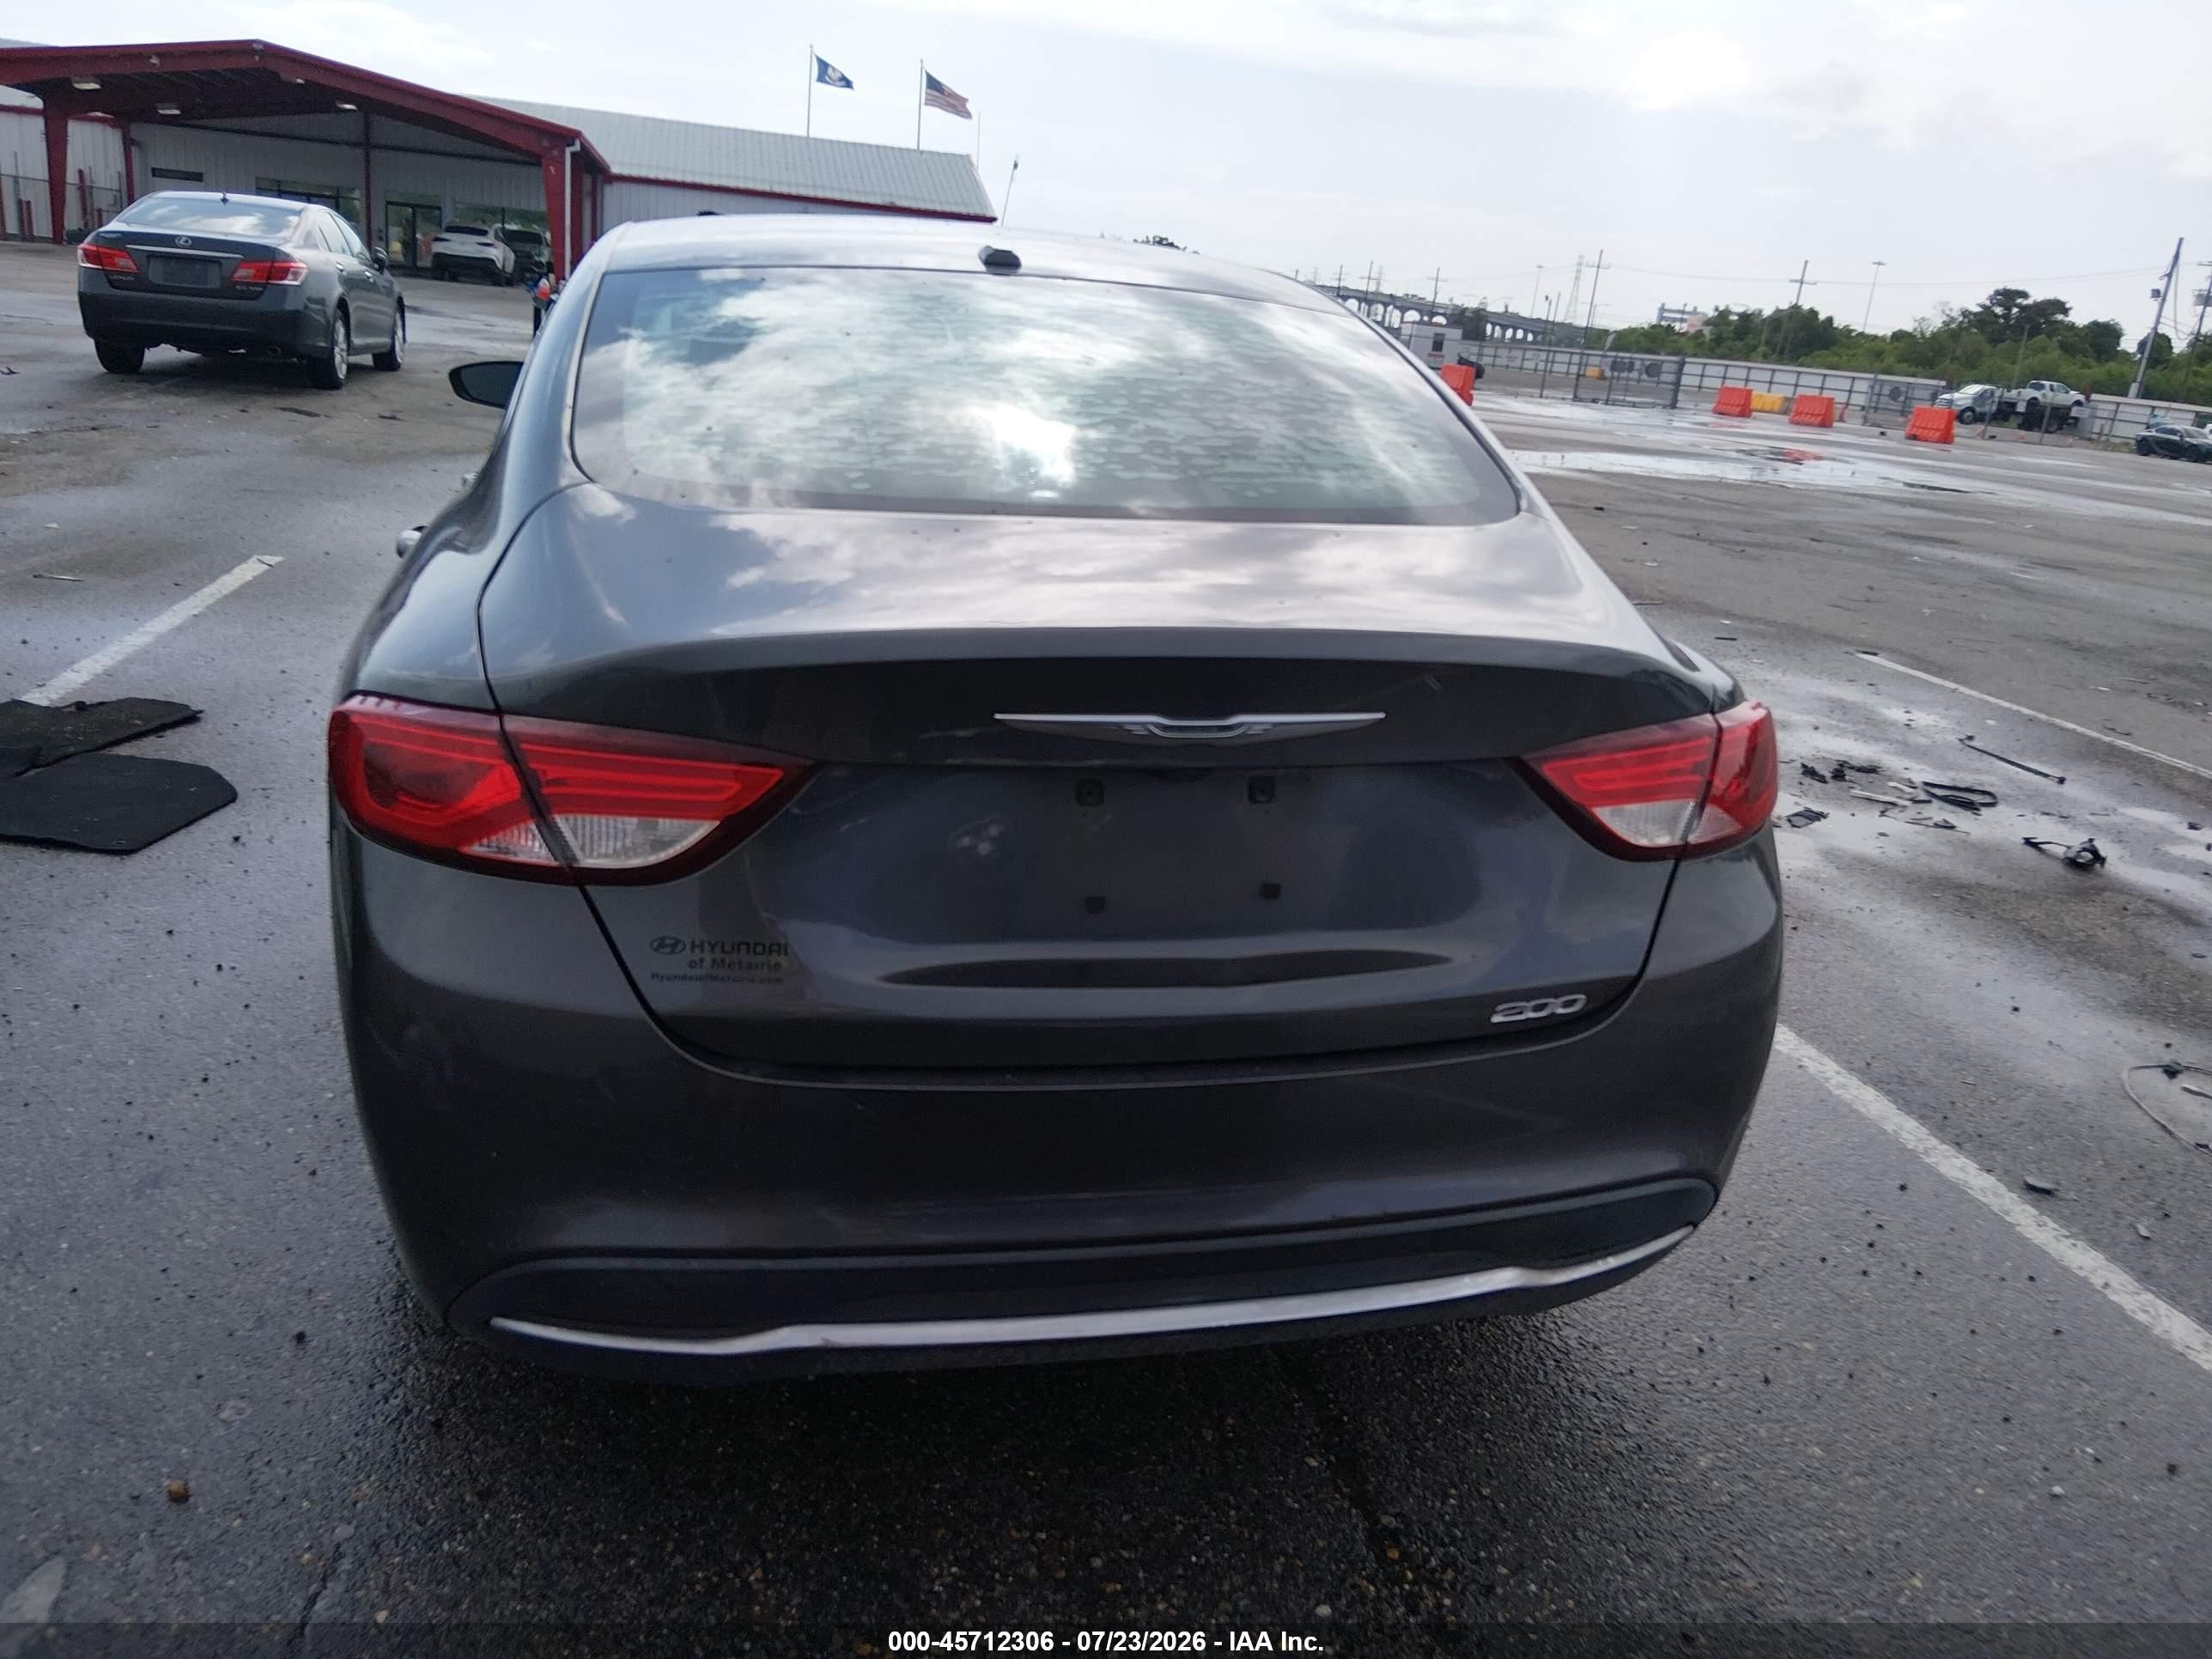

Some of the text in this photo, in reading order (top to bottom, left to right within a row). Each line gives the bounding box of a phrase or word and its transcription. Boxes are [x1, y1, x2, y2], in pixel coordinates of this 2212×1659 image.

[690, 939, 789, 957] HYUNDAI
[688, 957, 706, 969] of
[1490, 994, 1588, 1024] 200
